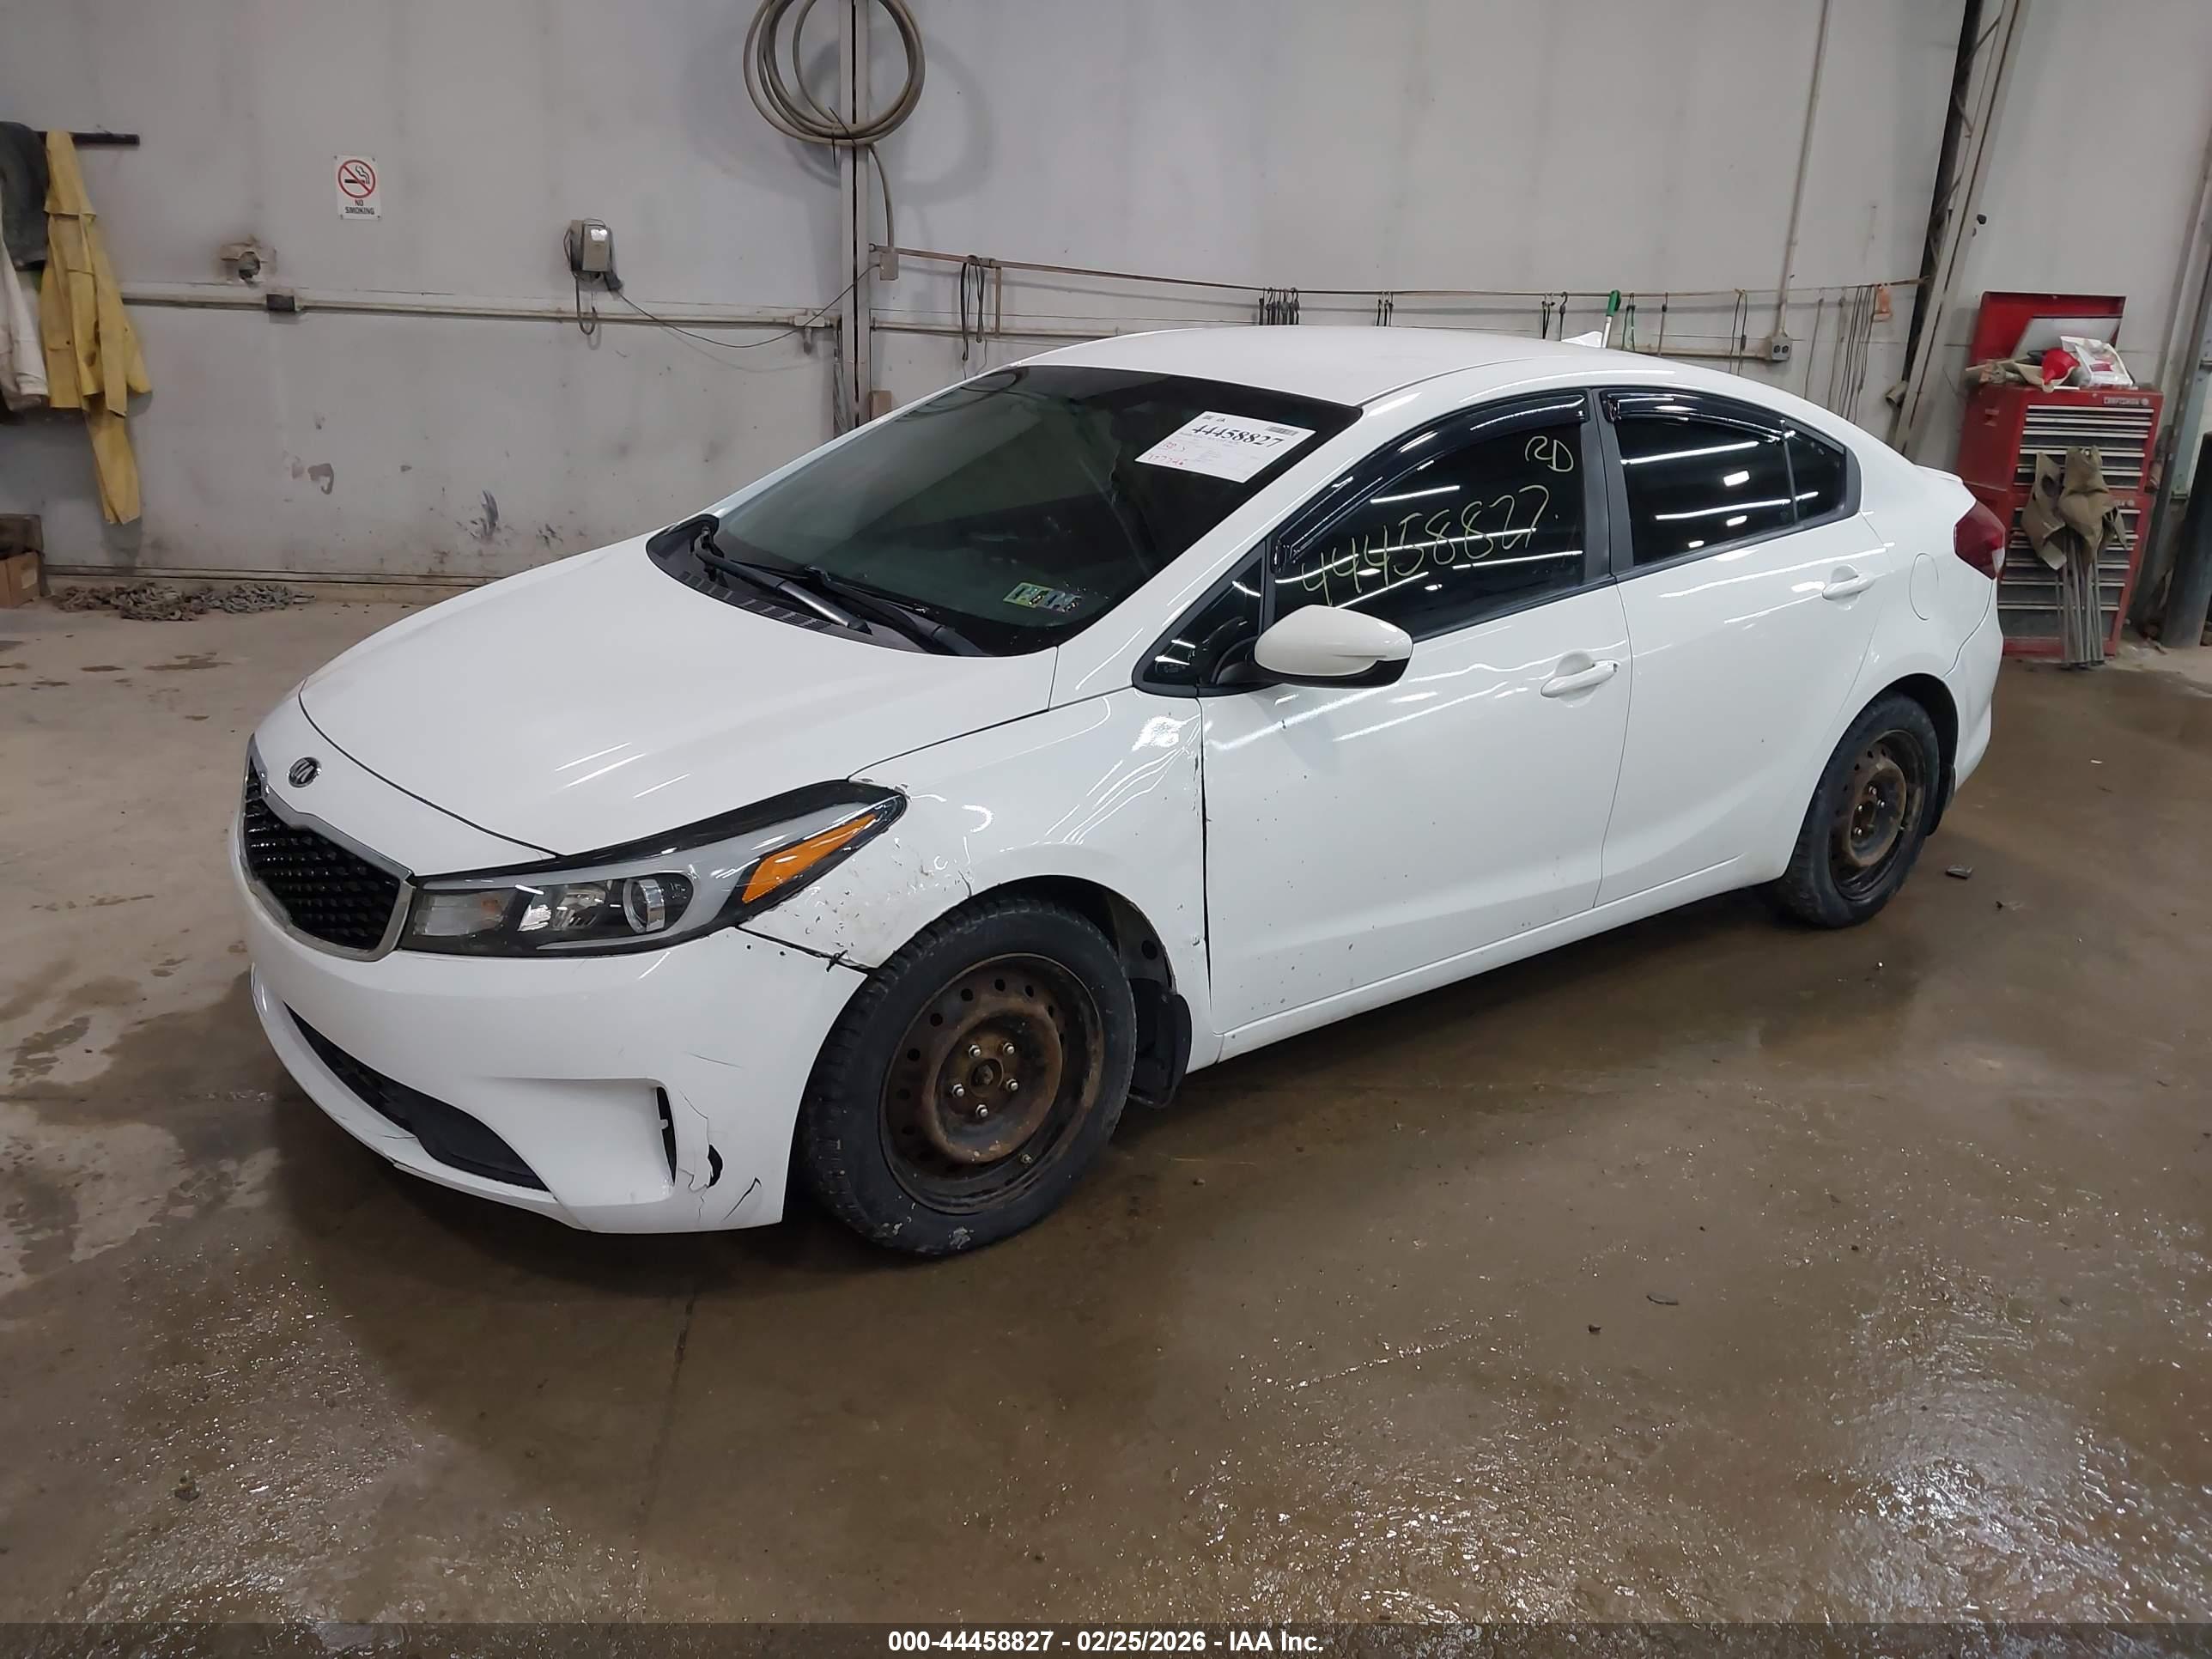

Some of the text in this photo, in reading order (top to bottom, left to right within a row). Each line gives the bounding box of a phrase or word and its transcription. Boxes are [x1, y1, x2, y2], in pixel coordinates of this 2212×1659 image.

[344, 206, 375, 215] SMOKING
[1192, 424, 1285, 447] 44458827
[1301, 484, 1549, 606] 44458827
